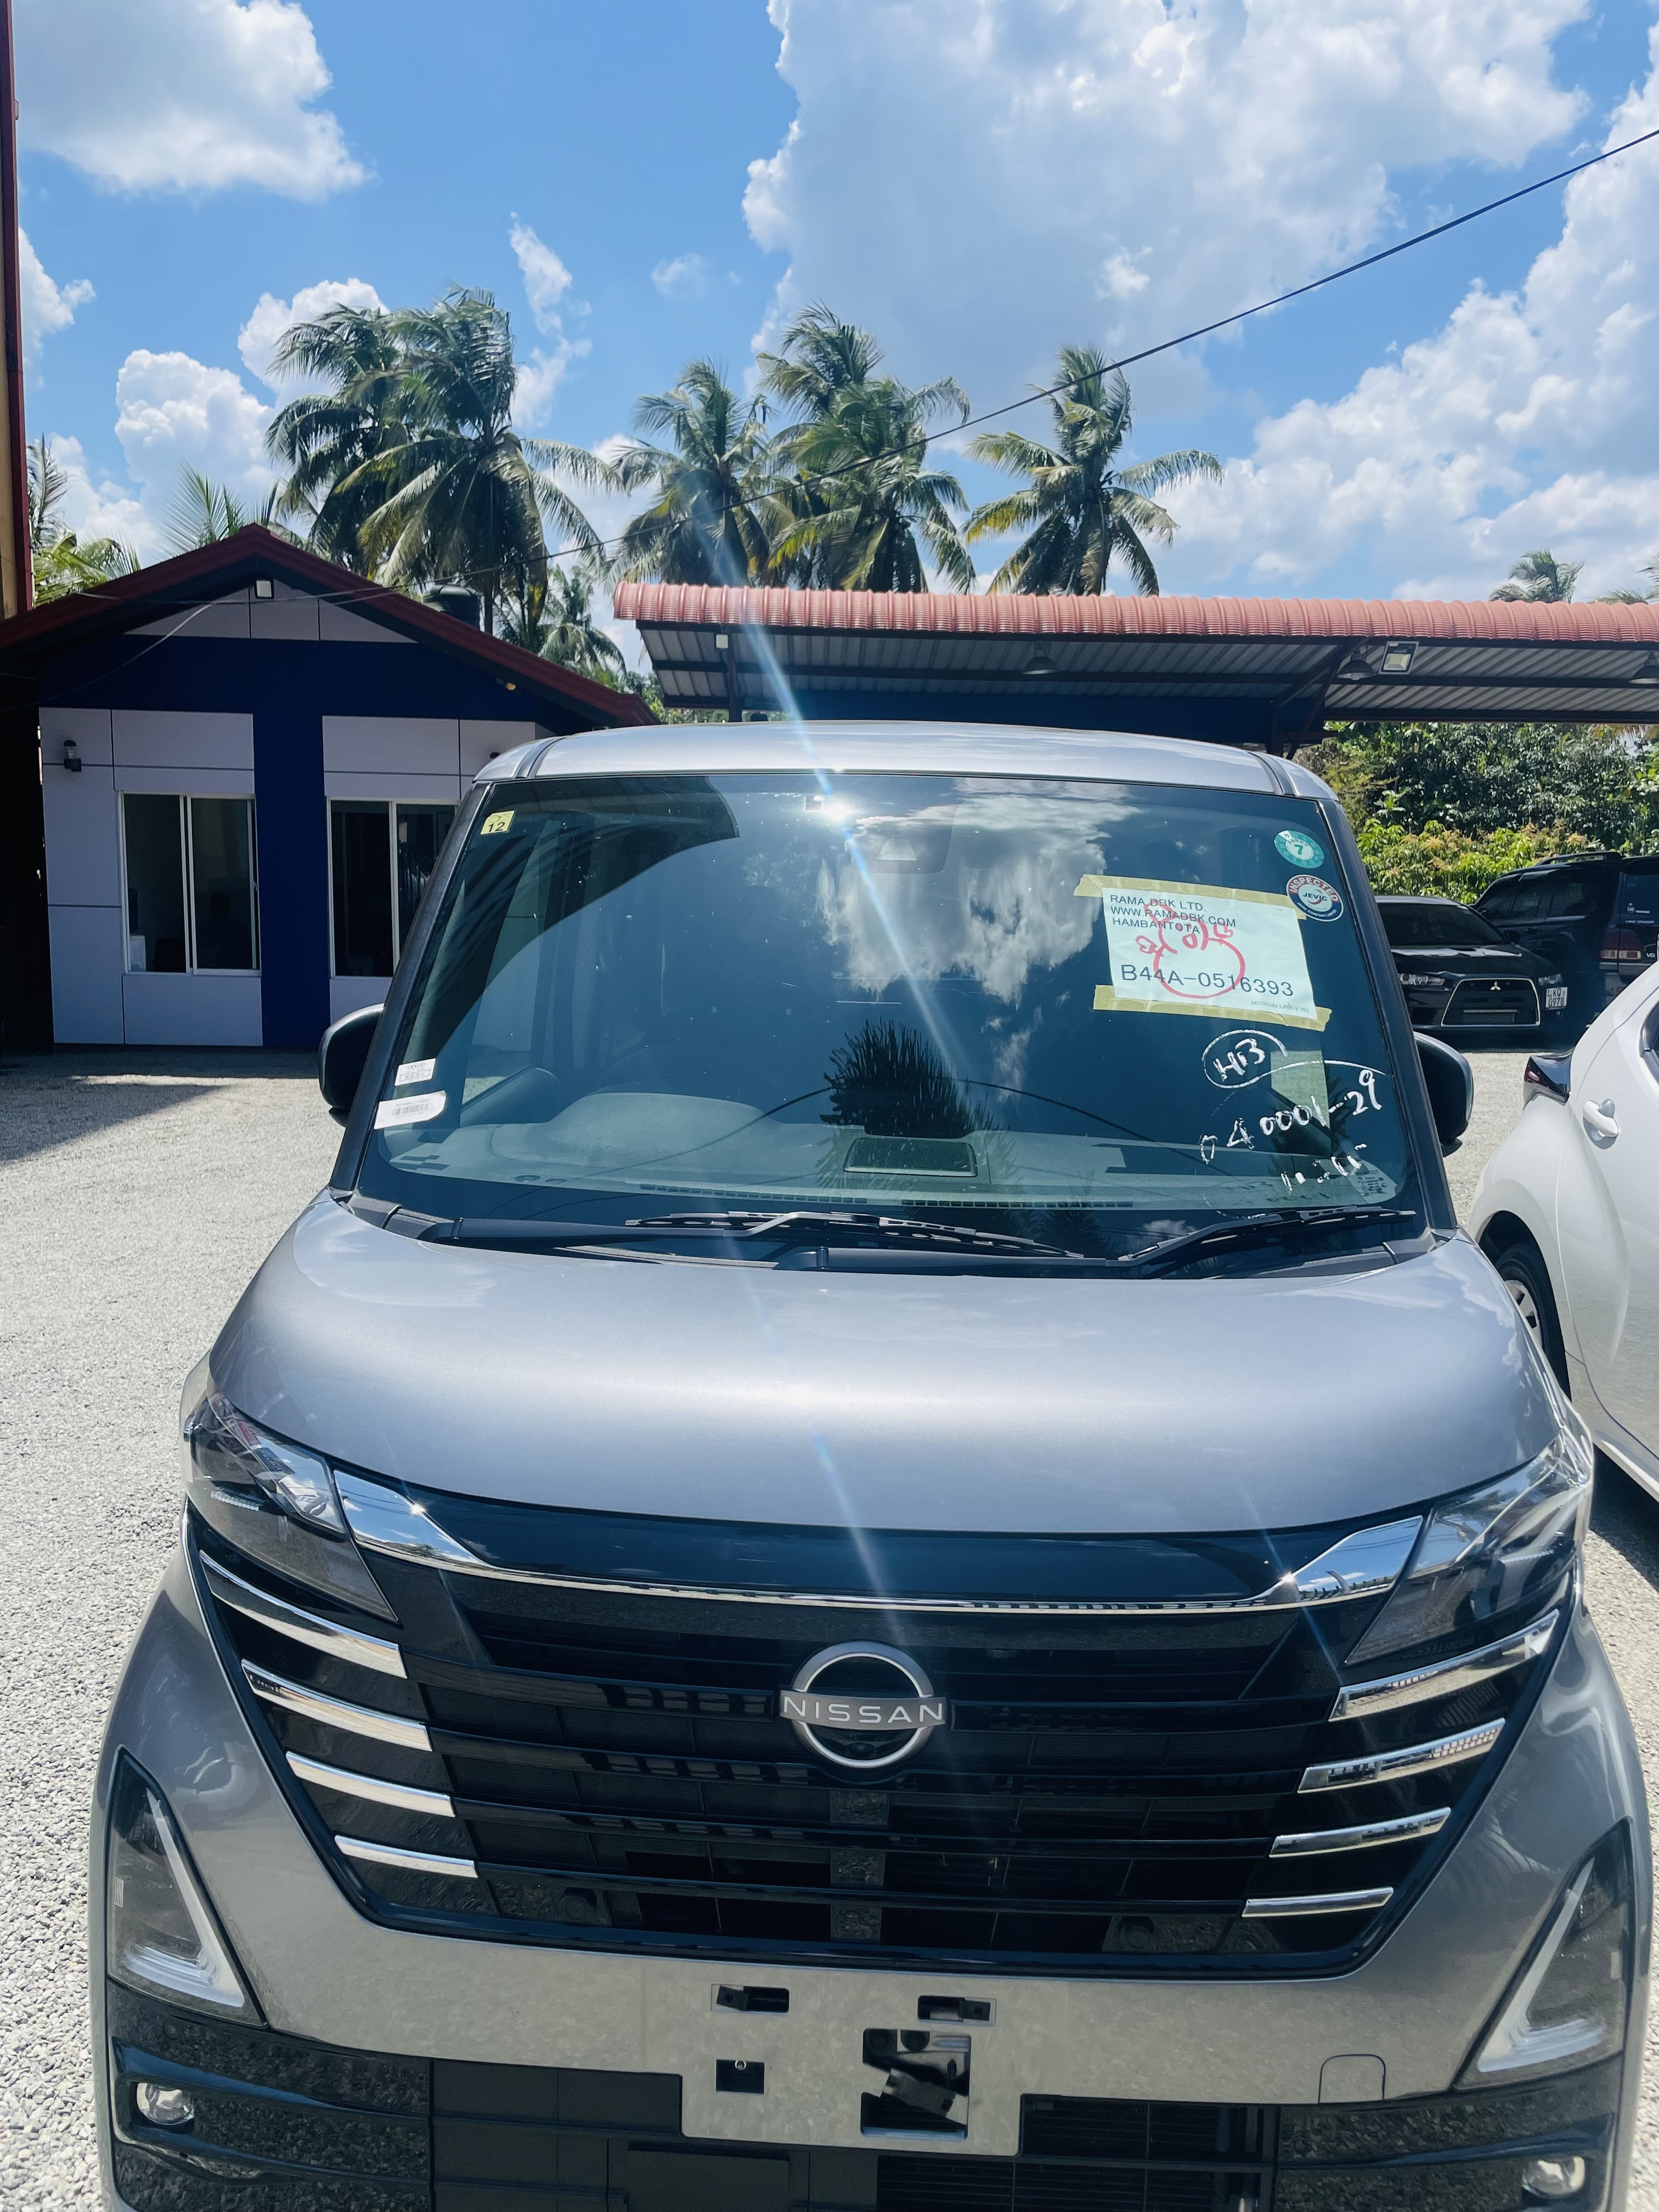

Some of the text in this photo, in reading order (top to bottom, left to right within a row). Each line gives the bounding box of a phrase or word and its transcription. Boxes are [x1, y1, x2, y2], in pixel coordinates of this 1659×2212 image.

[488, 822, 505, 833] 12
[1294, 844, 1304, 855] 7
[1289, 877, 1339, 901] INSPECTED
[1302, 893, 1328, 901] JEVIC
[1110, 895, 1206, 912] RAMA DBK LTD.
[1110, 906, 1236, 927] WWW.RAMADBK.COM
[1113, 917, 1200, 934] HAMBANTOTA
[1121, 964, 1294, 997] B44A-0516393
[1548, 997, 1564, 1007] 0978
[783, 1696, 943, 1724] NISSAN
